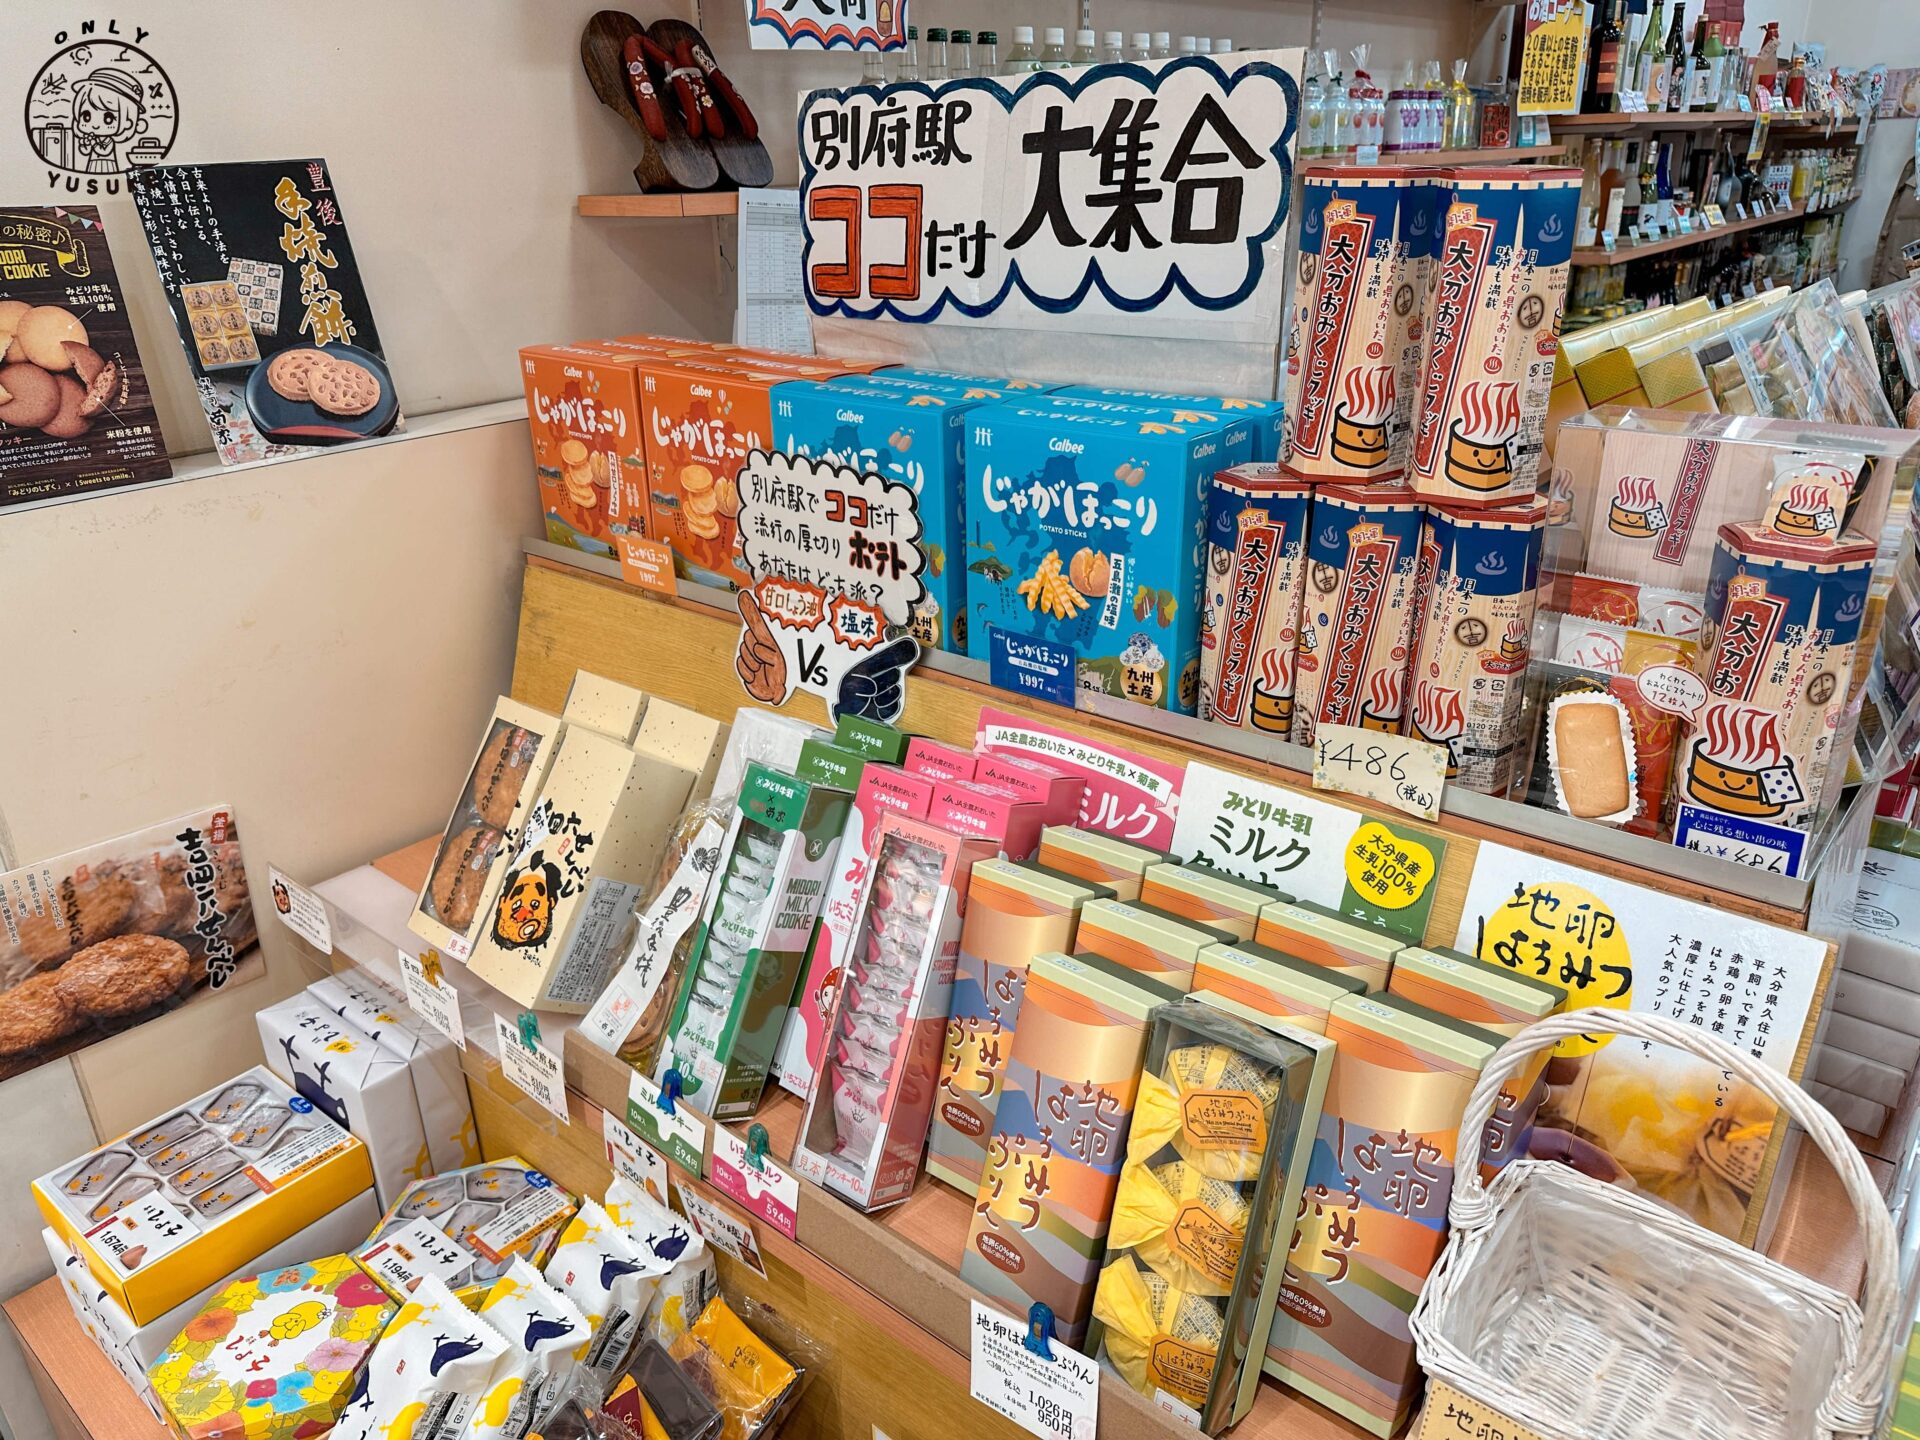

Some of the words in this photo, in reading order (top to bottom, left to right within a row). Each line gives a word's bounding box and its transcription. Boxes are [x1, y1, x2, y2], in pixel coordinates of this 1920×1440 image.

[54, 19, 149, 45] ONLY
[810, 98, 973, 171] 別府駅
[48, 171, 135, 196] YUSU
[1003, 92, 1266, 253] 大集合
[161, 168, 188, 230] 人情豊かな
[176, 167, 212, 246] 今日に伝える、
[306, 162, 343, 227] 豊後
[191, 167, 230, 264] 古来よりの手法を
[809, 183, 996, 300] ココだけ
[3, 263, 51, 280] COOKIE
[1521, 249, 1538, 293] 日本一の
[65, 284, 111, 296] みどり牛乳
[69, 295, 114, 305] 生乳100%
[97, 303, 116, 312] 使用
[1302, 235, 1356, 442] 大分おみくじクッキー
[564, 366, 583, 379] Calbee
[690, 383, 712, 399] Calbee
[533, 386, 627, 438] じゃがほっこり
[836, 408, 865, 425] Calbee
[106, 425, 152, 439] 米粉を使用
[652, 404, 761, 459] じゃがほっこり
[1049, 437, 1085, 455] Calbee
[1193, 442, 1217, 460] Calbee
[983, 463, 1157, 536] じゃがほっこり
[1039, 524, 1064, 535] POTATO
[1064, 527, 1088, 538] STICKS
[764, 586, 818, 620] 甘口しょう油
[1103, 557, 1123, 627] 五島灘の塩味
[1457, 578, 1477, 616] 日本一の
[840, 609, 876, 636] 塩味
[1222, 539, 1269, 709] 大分おみくじクッキー
[1327, 554, 1381, 720] 大分おみくじクッキ
[1006, 638, 1069, 667] じゃがほっこり
[1018, 672, 1045, 690] ¥997
[1127, 666, 1155, 685] 九州
[1660, 672, 1687, 686] わくわく
[1127, 683, 1155, 700] 土産
[1652, 690, 1688, 709] 12枚入
[1318, 738, 1409, 780] ¥486
[1222, 790, 1313, 836] みどり牛乳
[1209, 815, 1310, 873] ミルク
[1693, 820, 1788, 850] 心に残る想い出の味
[1372, 833, 1422, 878] 大分県産
[1352, 844, 1417, 896] 生乳100%
[787, 877, 819, 897] MIDORI
[1361, 872, 1390, 896] 使用
[785, 895, 813, 912] MILK
[1507, 881, 1615, 950] 地卵
[775, 911, 812, 931] COOKIE
[448, 939, 470, 956] 見本
[1477, 914, 1633, 1000] はちみつ
[675, 1145, 698, 1169] 594円
[797, 1154, 821, 1177] 見本
[716, 1165, 734, 1184] 10枚入
[766, 1204, 791, 1229] 594円
[100, 1230, 127, 1257] 1,674円
[382, 1257, 411, 1283] 1,194円
[225, 1333, 272, 1373] ひよ子
[1003, 1377, 1021, 1395] 税込
[1029, 1390, 1073, 1426] 1,026円
